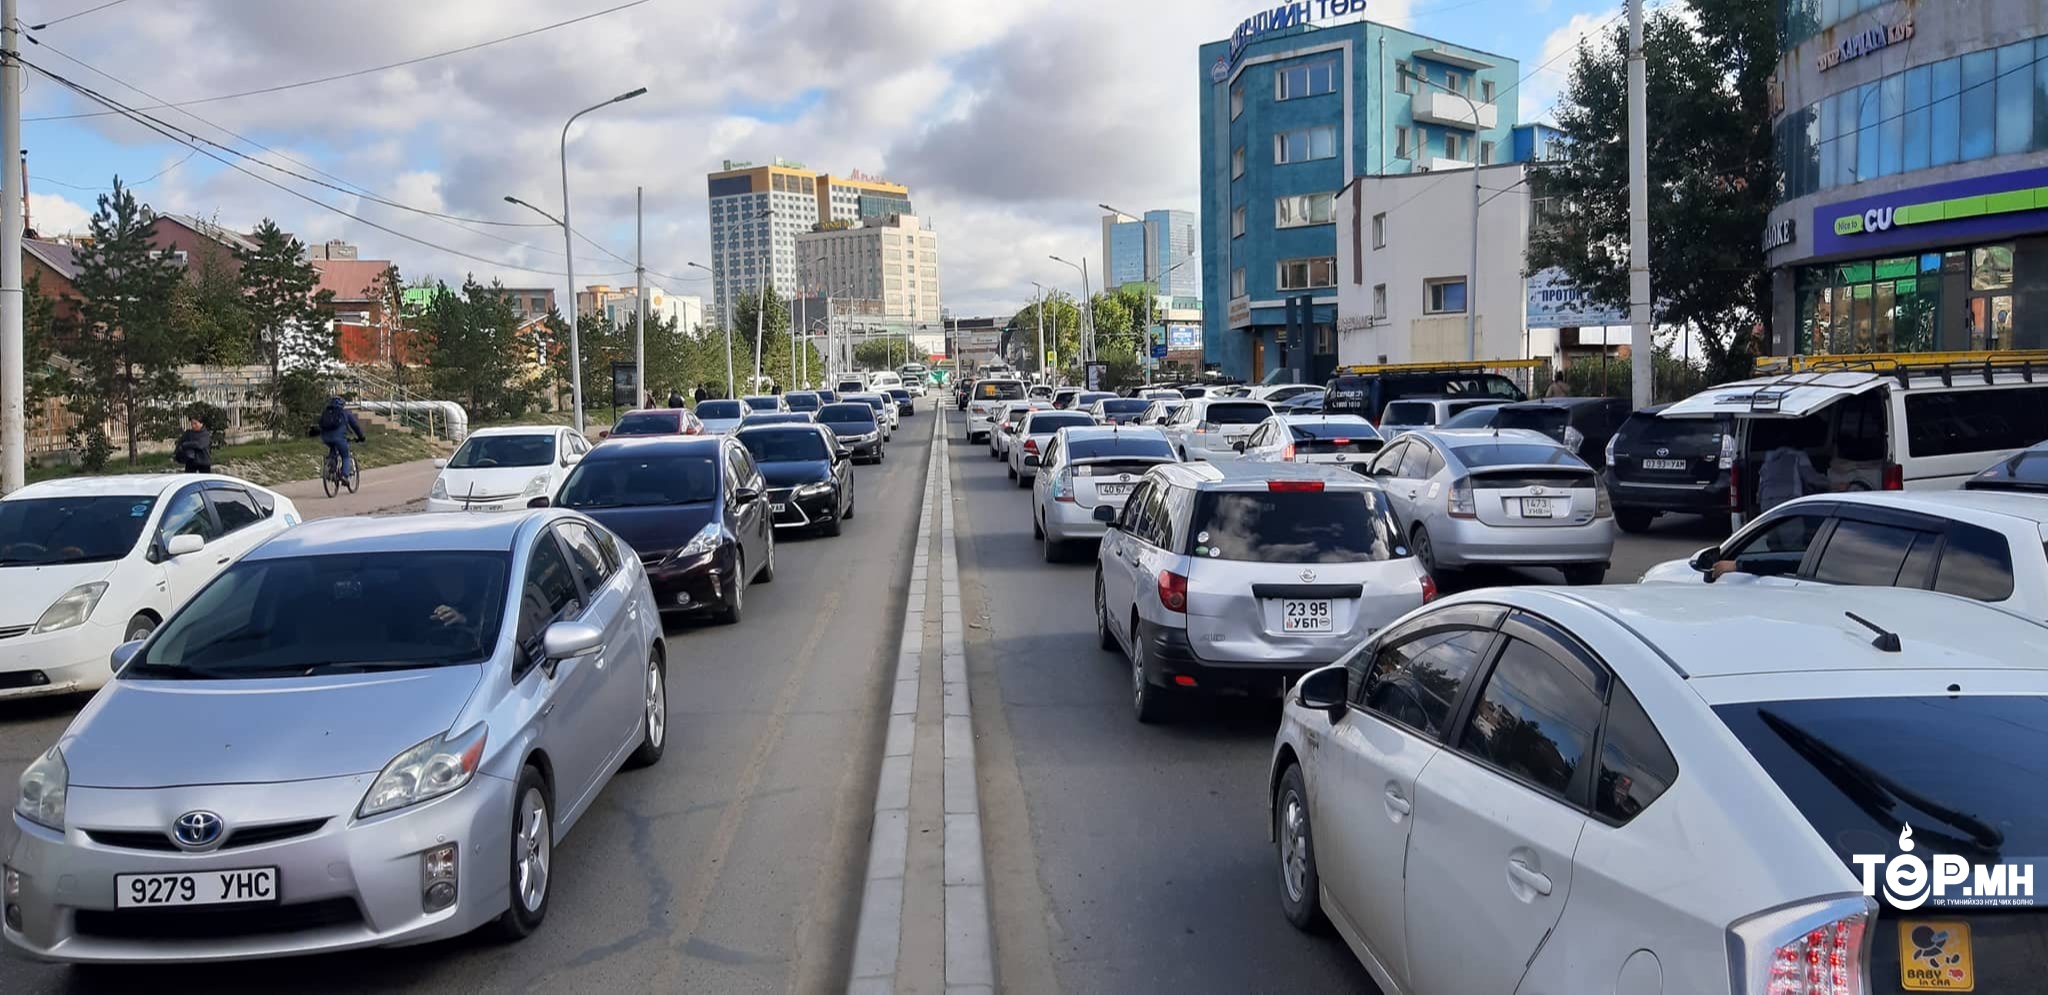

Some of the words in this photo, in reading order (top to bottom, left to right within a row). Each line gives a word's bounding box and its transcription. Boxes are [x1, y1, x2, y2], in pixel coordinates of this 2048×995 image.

[1864, 206, 1892, 233] CU
[1294, 618, 1318, 629] УБП
[131, 876, 196, 903] 9279
[220, 871, 270, 899] УНС
[1907, 969, 1942, 979] BABY
